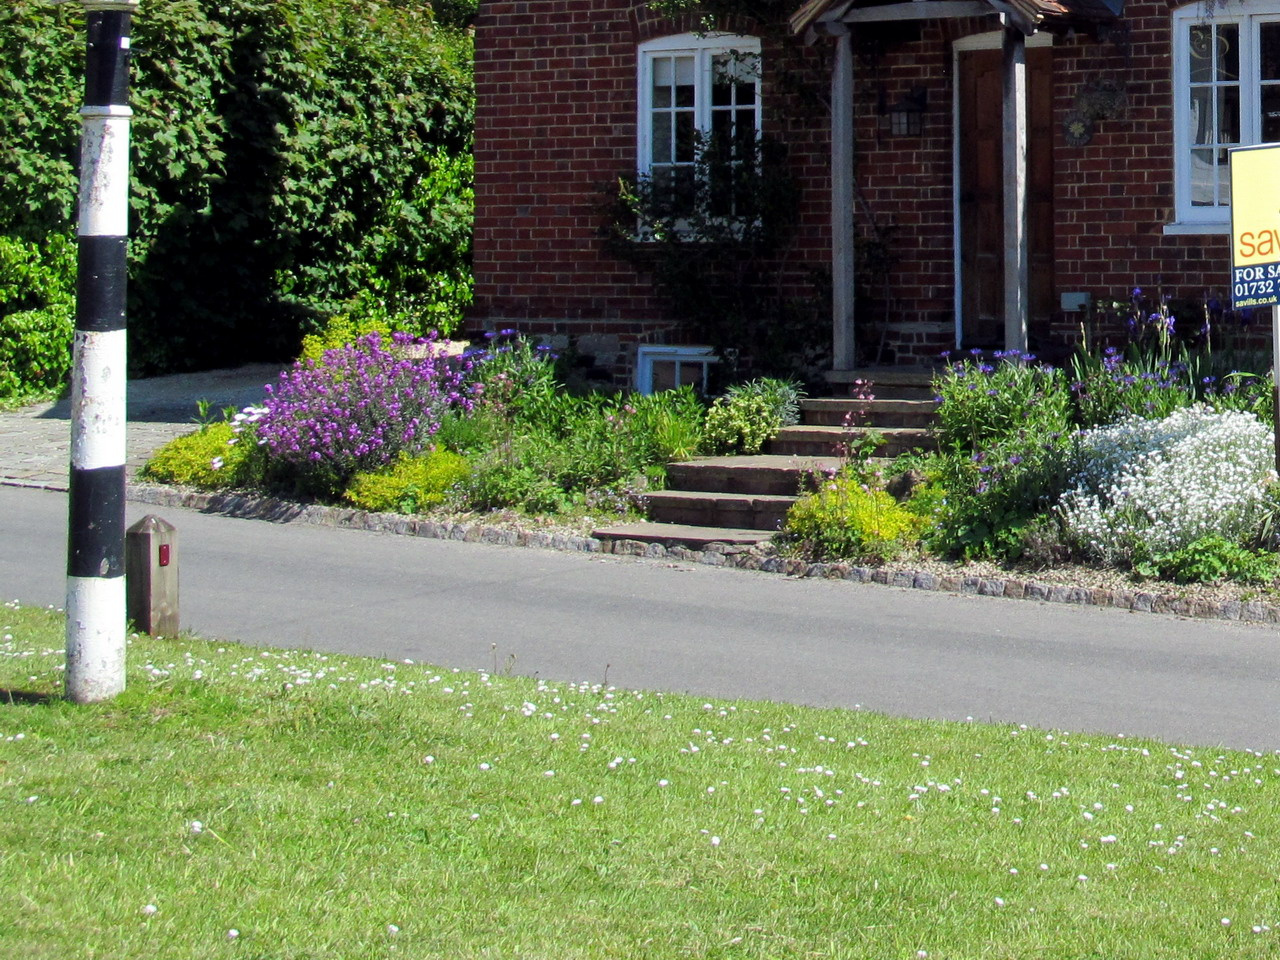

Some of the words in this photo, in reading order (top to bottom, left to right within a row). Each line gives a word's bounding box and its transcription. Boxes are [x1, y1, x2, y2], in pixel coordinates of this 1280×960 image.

[1235, 266, 1265, 282] FOR
[1234, 280, 1274, 297] 01732
[1235, 294, 1278, 308] savills.co.uk
